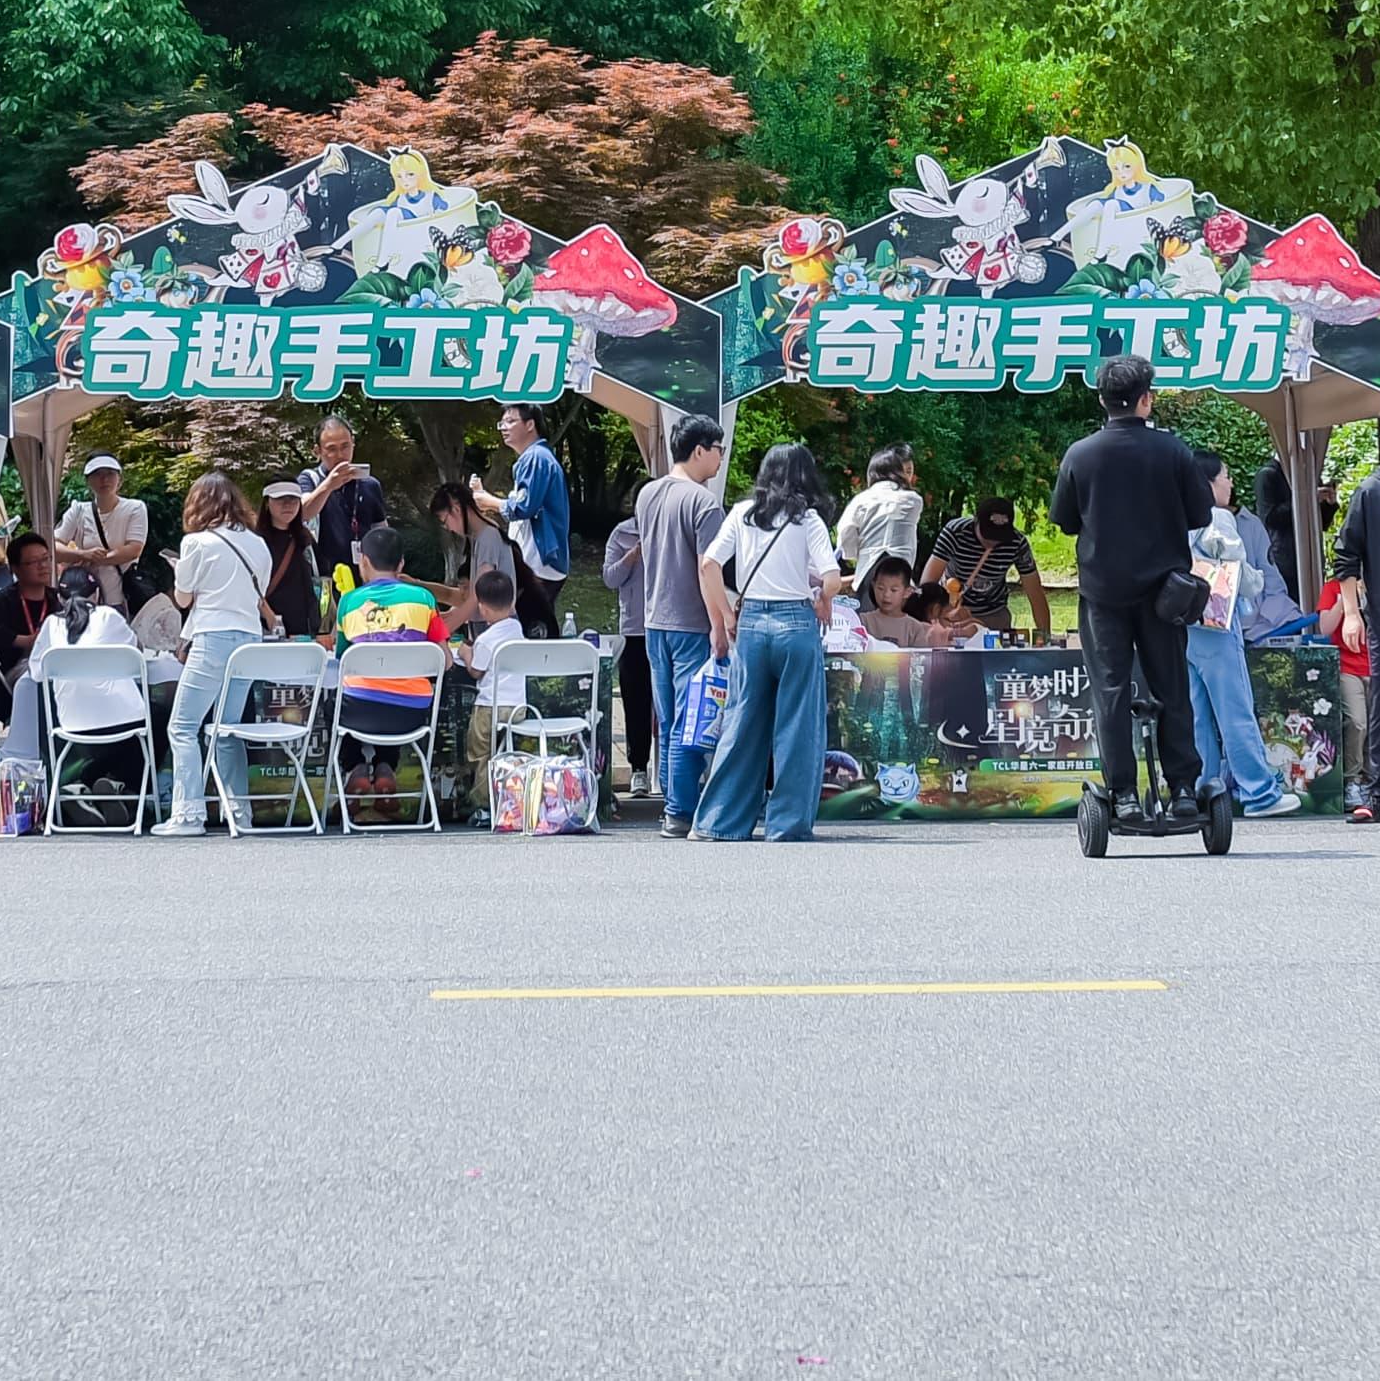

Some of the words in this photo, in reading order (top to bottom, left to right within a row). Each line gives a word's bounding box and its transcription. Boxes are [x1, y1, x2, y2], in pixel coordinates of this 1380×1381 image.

[89, 311, 565, 393] 奇趣手工坊
[816, 304, 1283, 383] 奇趣手工坊
